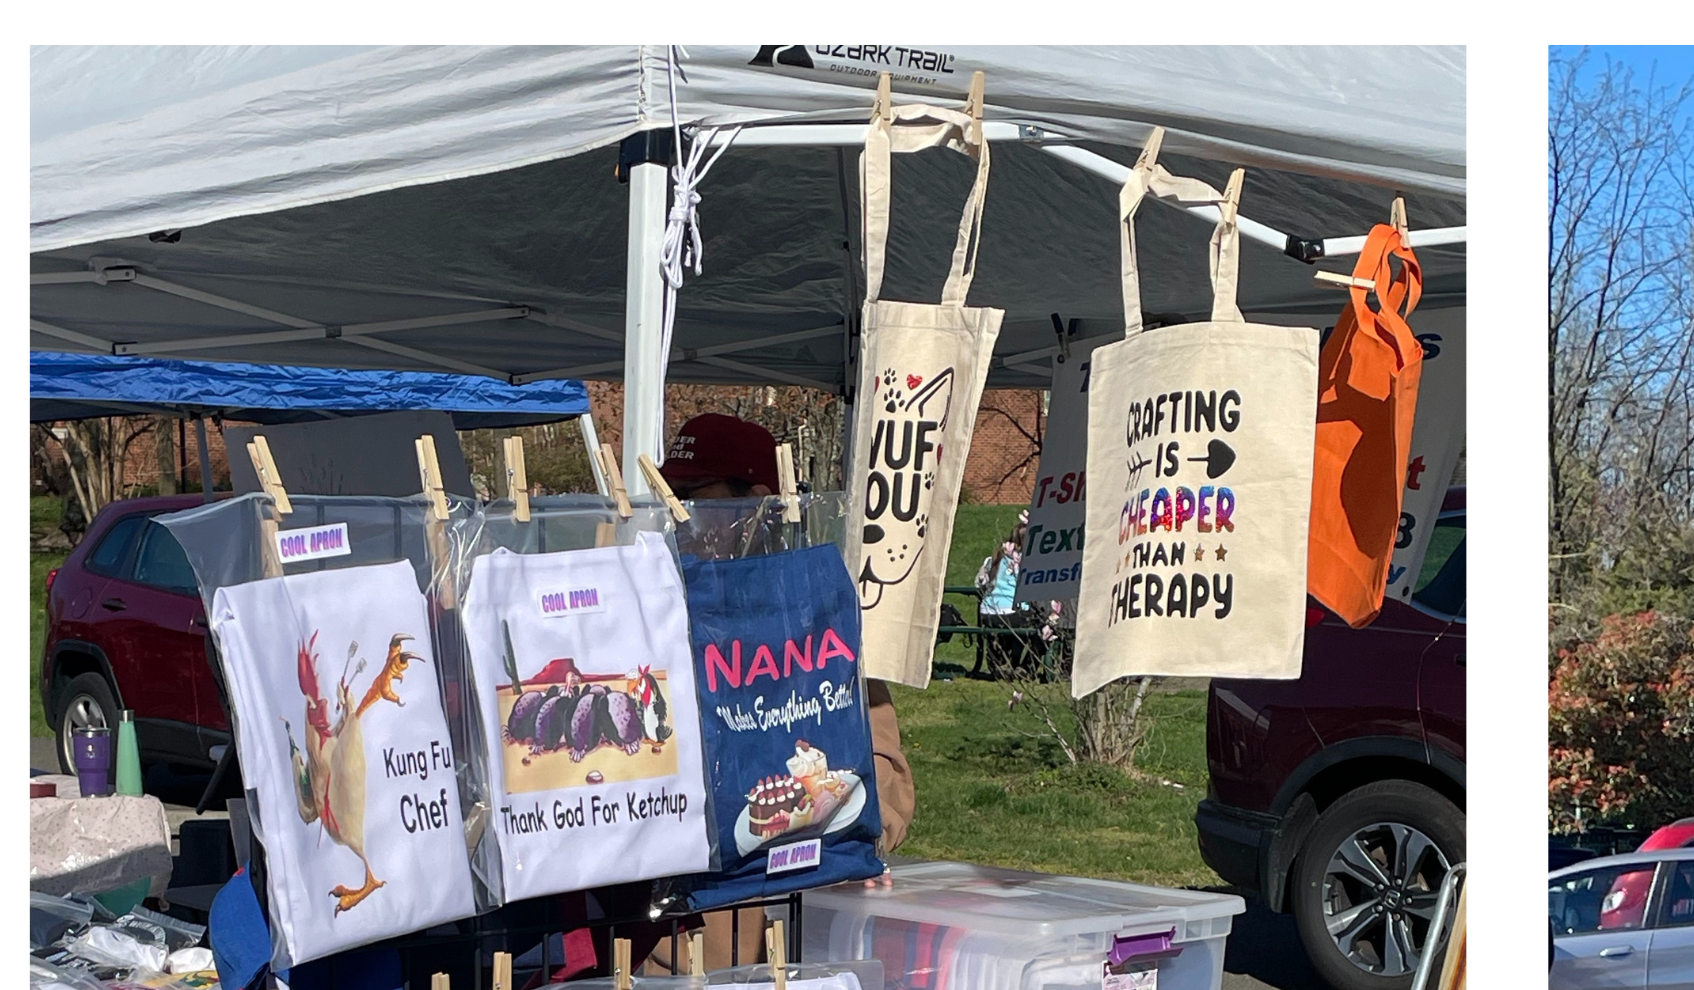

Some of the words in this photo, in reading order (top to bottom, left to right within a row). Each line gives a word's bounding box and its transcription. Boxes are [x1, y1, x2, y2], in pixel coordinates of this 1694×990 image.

[830, 64, 877, 78] OUTDOOR
[885, 72, 937, 85] QUIPMENT
[1126, 389, 1241, 448] CRAFTING
[1155, 441, 1180, 478] IS
[1118, 485, 1236, 546] CHEAPER
[280, 534, 306, 558] COOL
[310, 528, 342, 552] APRON
[1132, 541, 1186, 569] THAN
[541, 592, 567, 612] COOL
[568, 588, 599, 609] APRON
[1108, 572, 1234, 629] THERAPY
[704, 628, 856, 693] NANA
[754, 689, 822, 734] Everything
[383, 746, 428, 781] Kung
[430, 741, 451, 771] Fu
[399, 788, 449, 834] Chef
[500, 802, 549, 836] Thank
[553, 799, 585, 830] God
[591, 795, 620, 826] For
[626, 786, 688, 823] Ketchup
[770, 849, 788, 869] COOL
[790, 843, 817, 865] APRON
